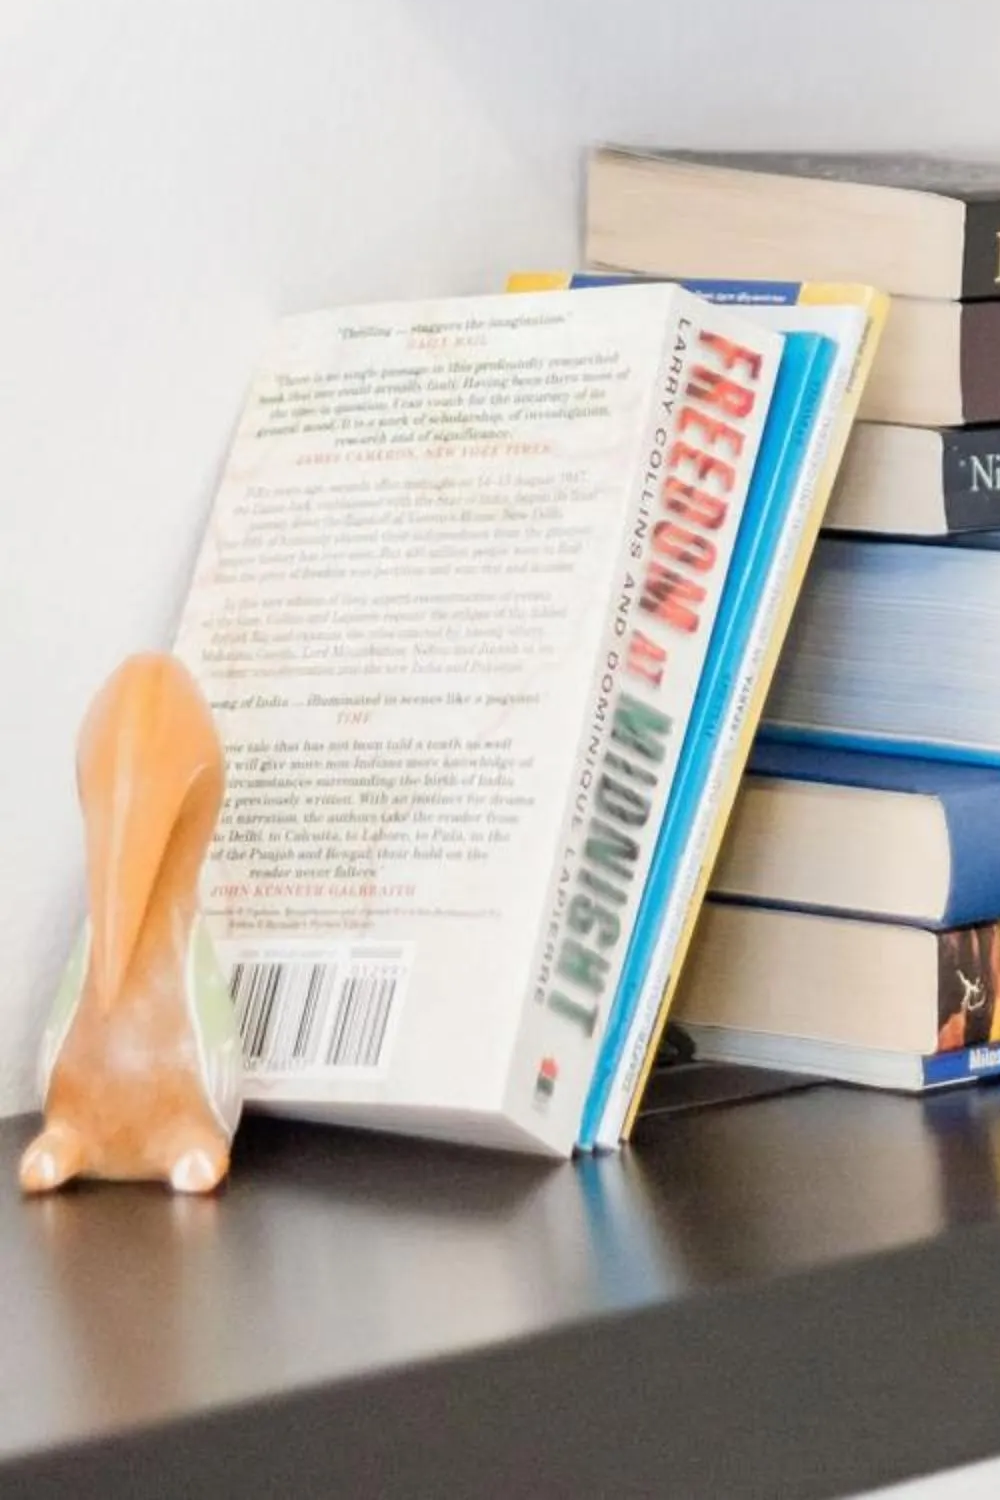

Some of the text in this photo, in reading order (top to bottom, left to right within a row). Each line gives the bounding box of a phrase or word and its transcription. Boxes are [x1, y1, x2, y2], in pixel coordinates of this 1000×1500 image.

[464, 317, 486, 330] the
[448, 361, 472, 374] this
[462, 374, 508, 392] Having
[490, 392, 510, 405] the
[639, 329, 763, 633] FREEDOM
[534, 318, 692, 1007] LARRY COLLINS AND DOMINIQUE LAPIERRE
[626, 631, 667, 689] AT
[255, 695, 288, 708] India
[446, 691, 470, 704] like
[272, 741, 299, 753] that
[302, 740, 324, 752] has
[234, 761, 257, 774] will
[423, 774, 456, 786] birth
[359, 794, 388, 807] With
[226, 849, 246, 861] the
[546, 693, 673, 1038] MIDNIGHT
[210, 885, 249, 898] JOHN
